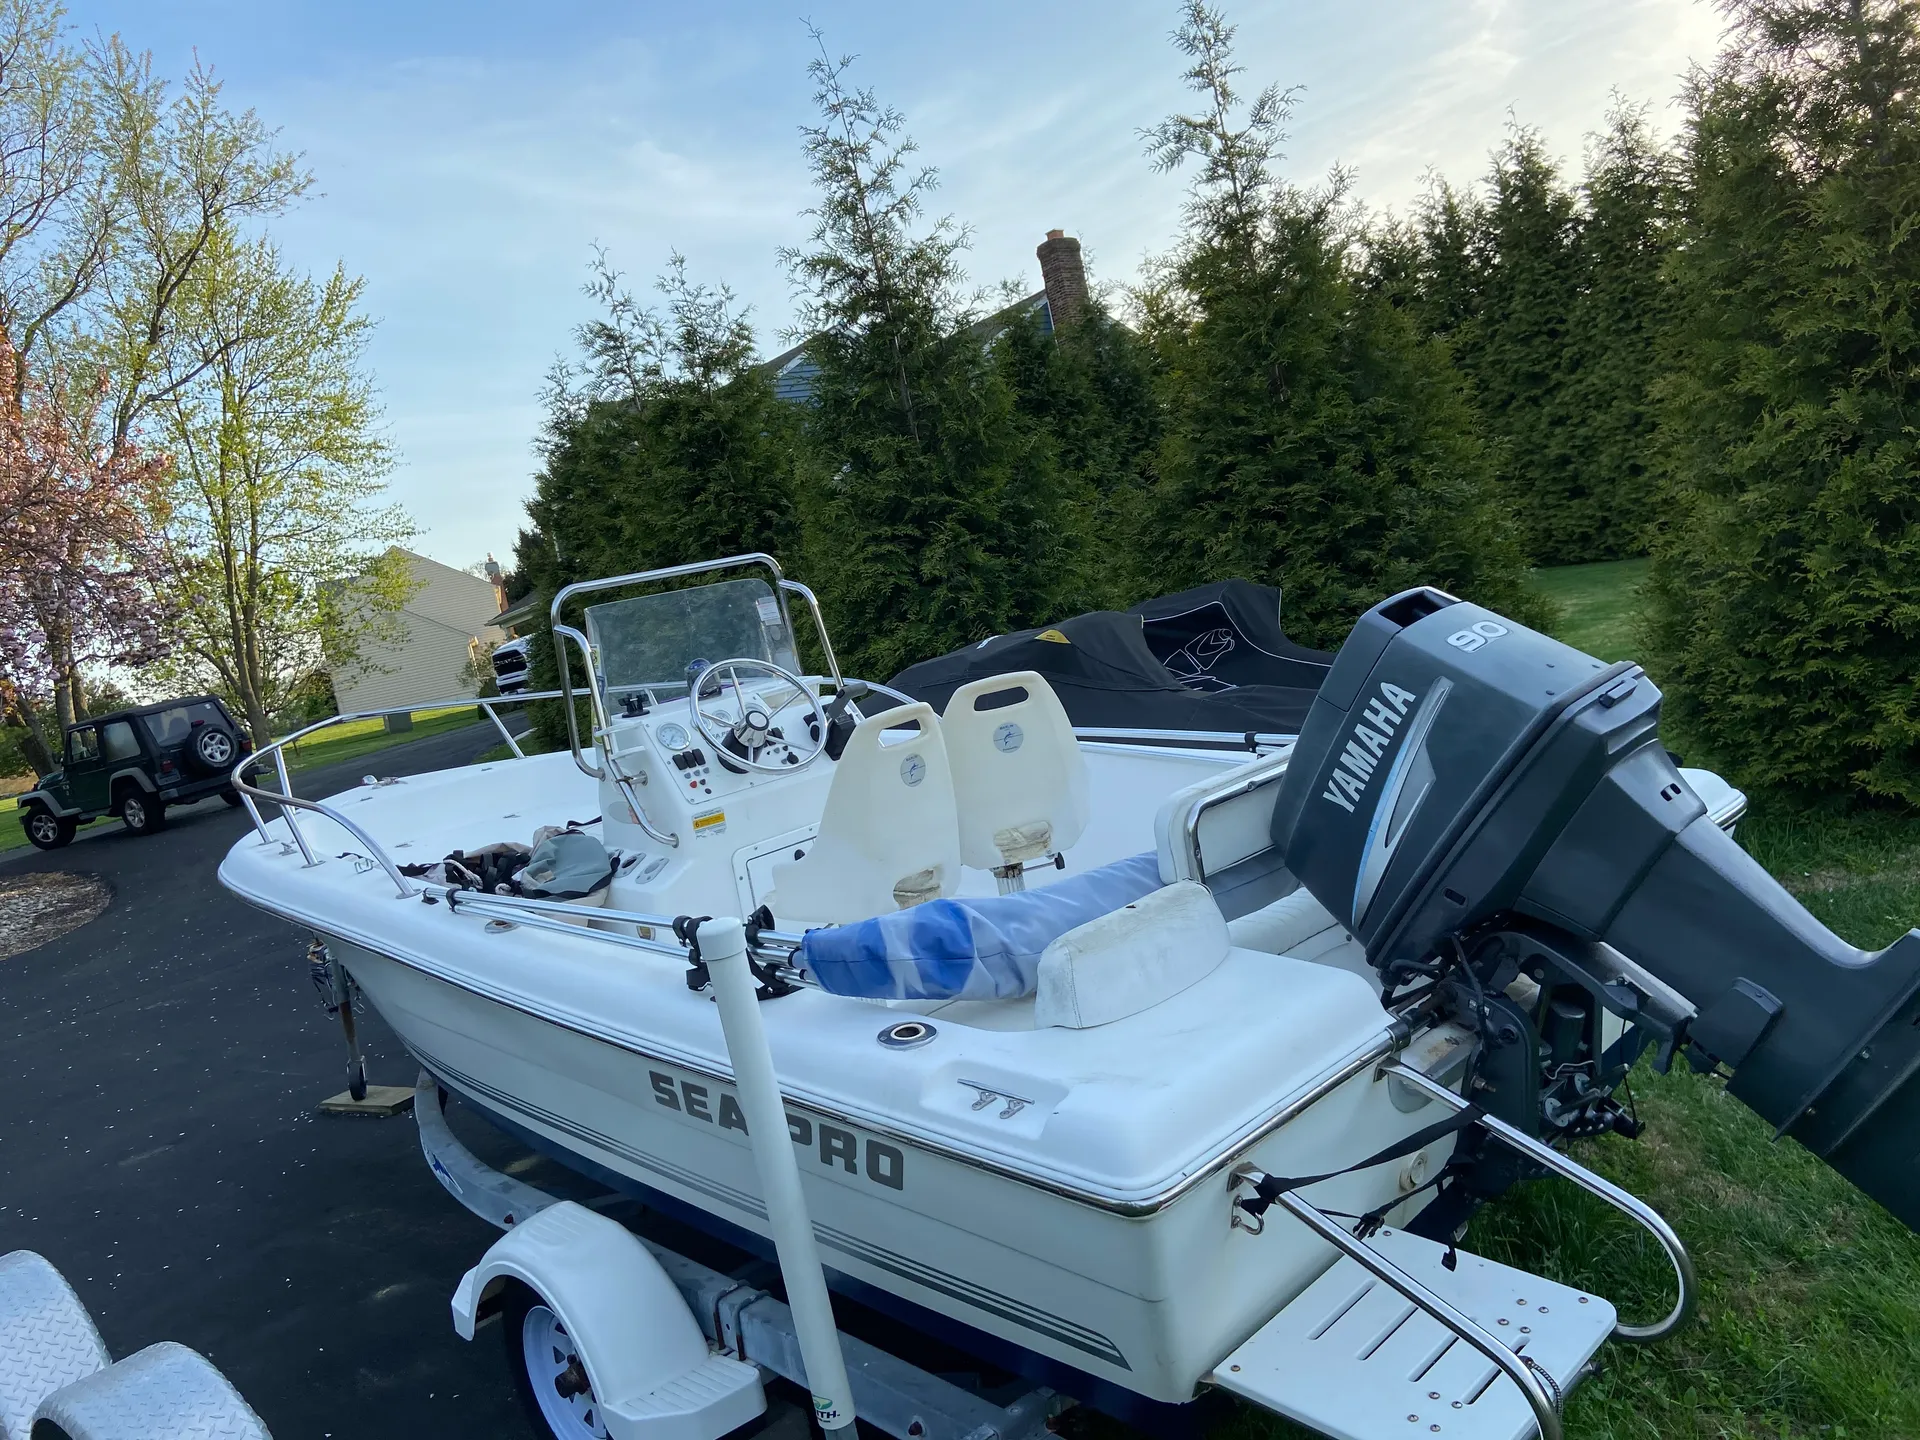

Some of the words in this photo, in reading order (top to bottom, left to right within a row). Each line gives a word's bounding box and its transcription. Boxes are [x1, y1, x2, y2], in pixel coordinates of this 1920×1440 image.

[1446, 620, 1510, 653] 90
[1323, 681, 1416, 814] YAMAHA
[649, 1070, 749, 1136] SEA
